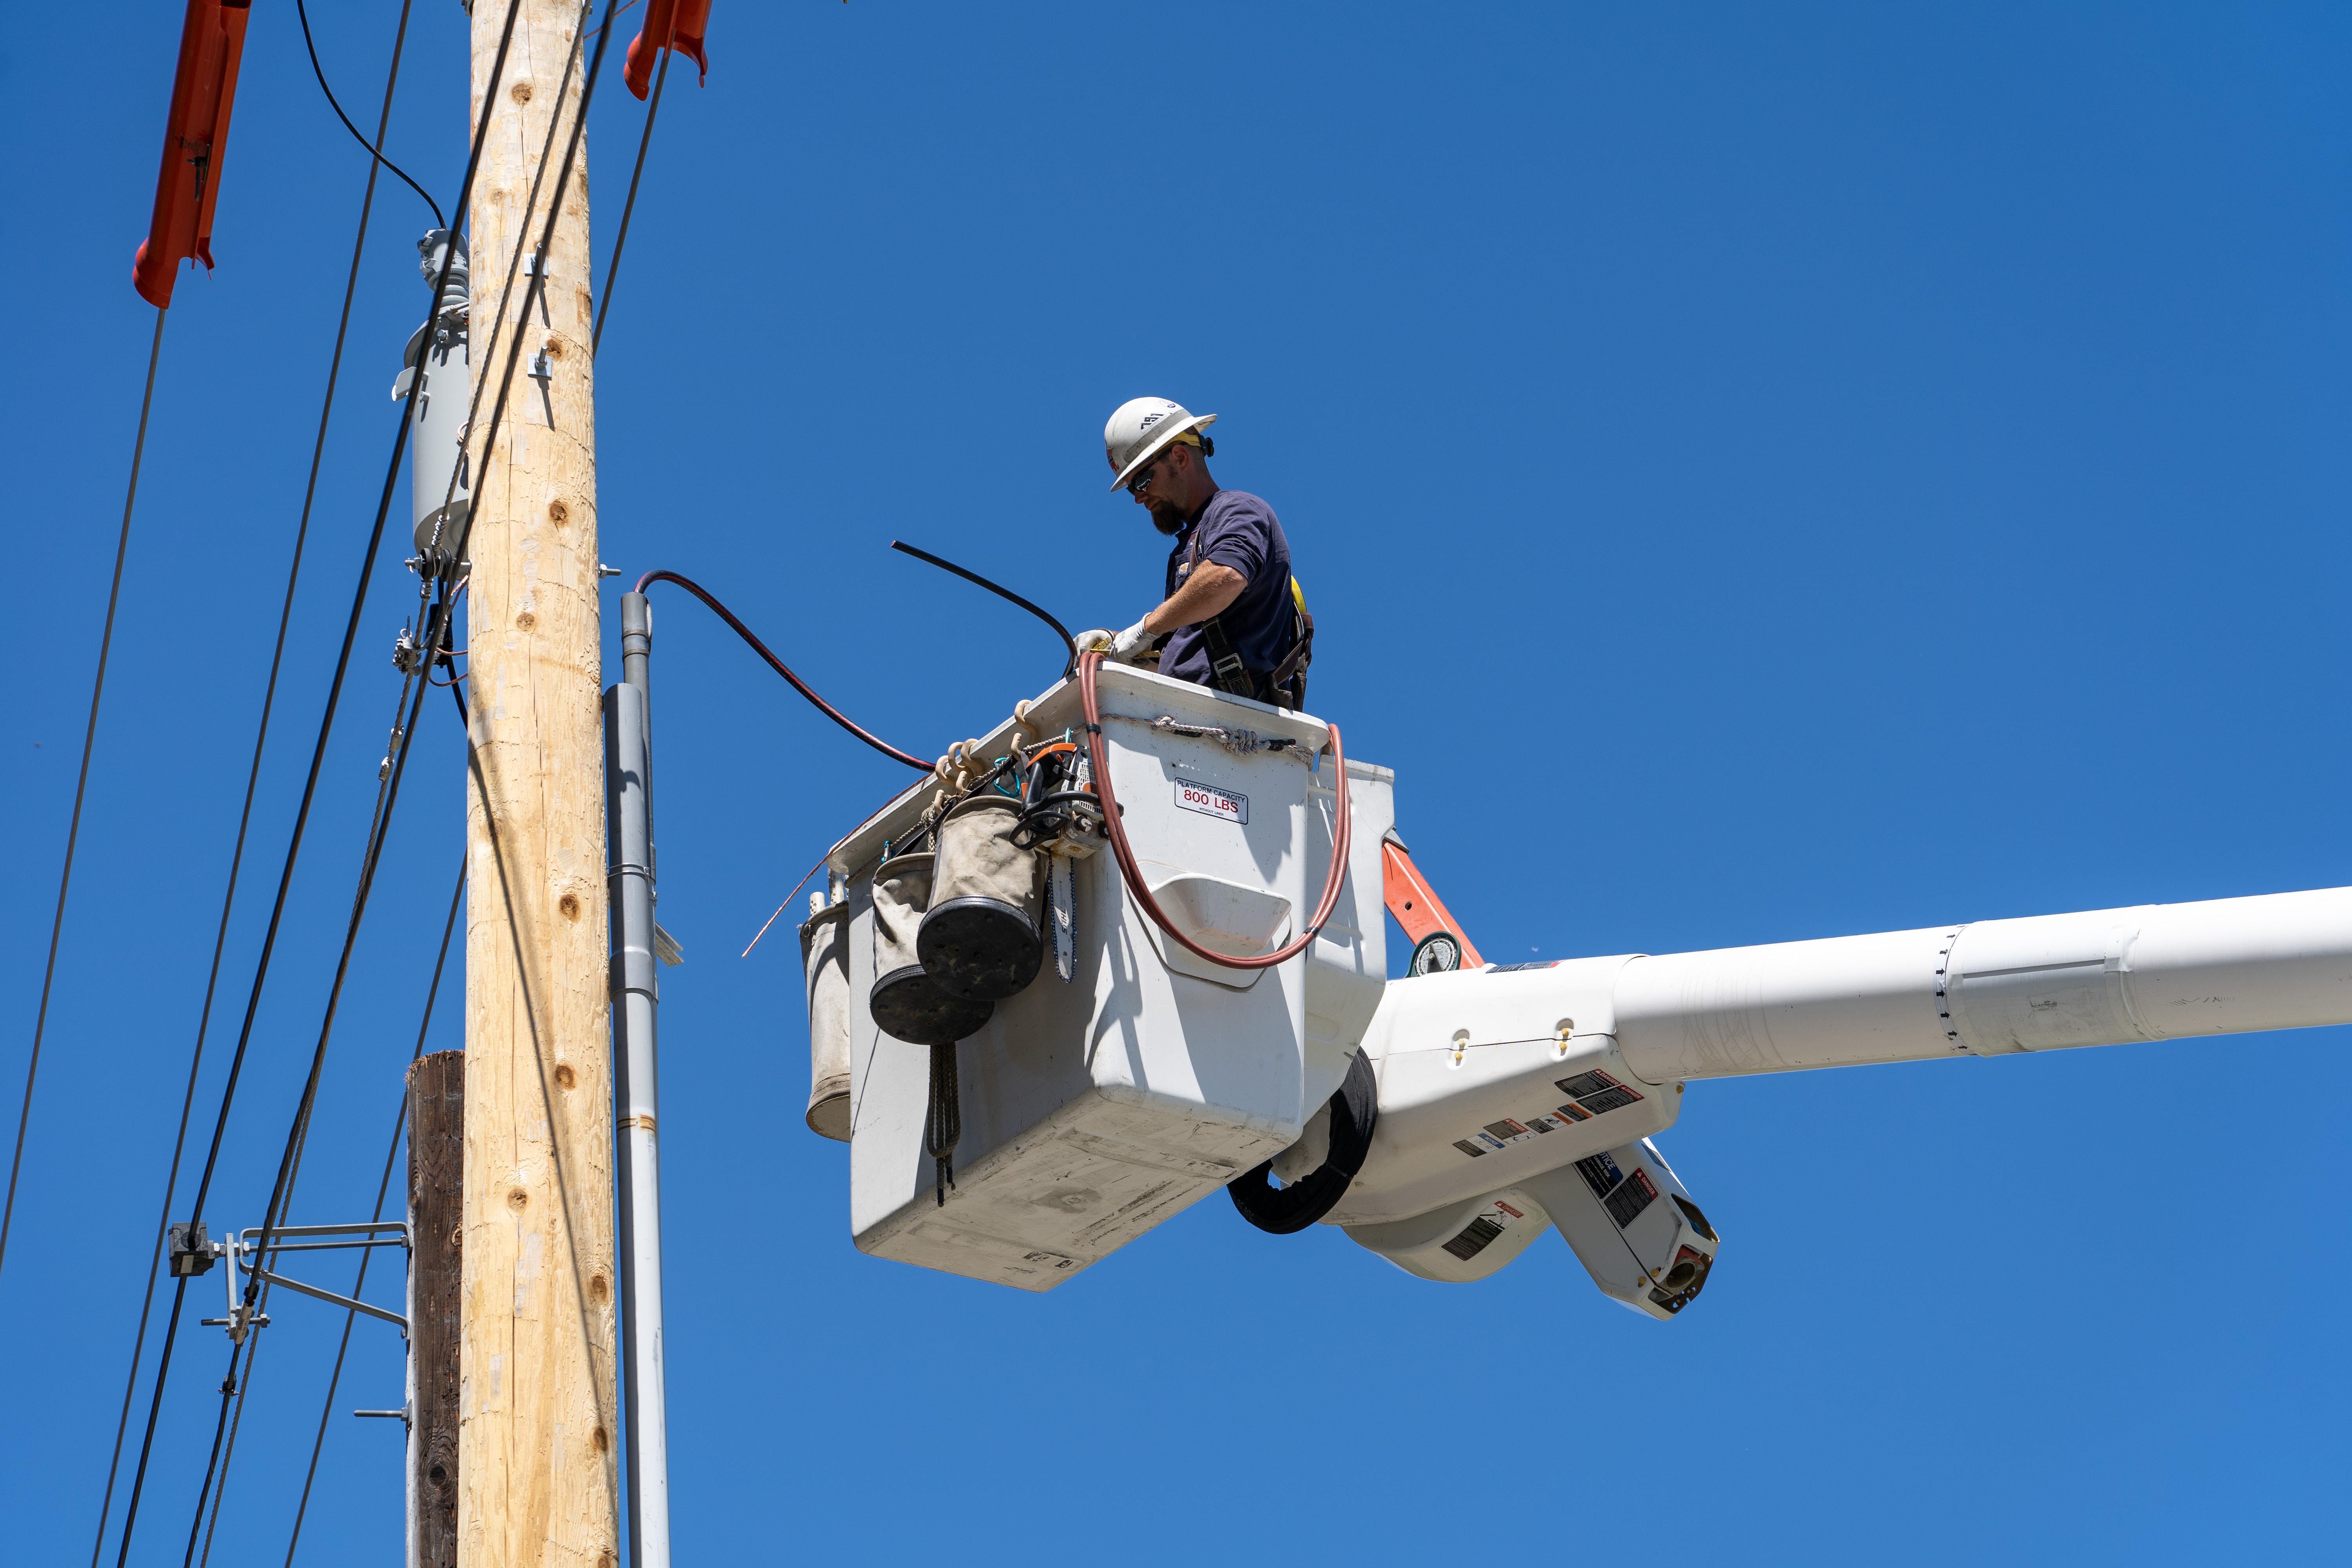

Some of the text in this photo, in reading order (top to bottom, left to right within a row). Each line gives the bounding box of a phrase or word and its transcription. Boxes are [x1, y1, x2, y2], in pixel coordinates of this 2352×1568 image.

[1178, 780, 1245, 802] PLATFORM CAPACITY
[1184, 789, 1238, 813] 800 LBS
[1599, 1073, 1619, 1085] DANGER
[1624, 1088, 1641, 1098] DANGER
[1573, 1106, 1590, 1116] WARNING
[1557, 1114, 1570, 1123] WARNING
[1509, 1122, 1525, 1131] DANGER
[1484, 1136, 1499, 1145] NOTICE
[1594, 1156, 1604, 1170] DAMAGE
[1599, 1151, 1615, 1170] OTICE
[1641, 1177, 1655, 1195] DANGER
[1502, 1205, 1521, 1216] DANGER
